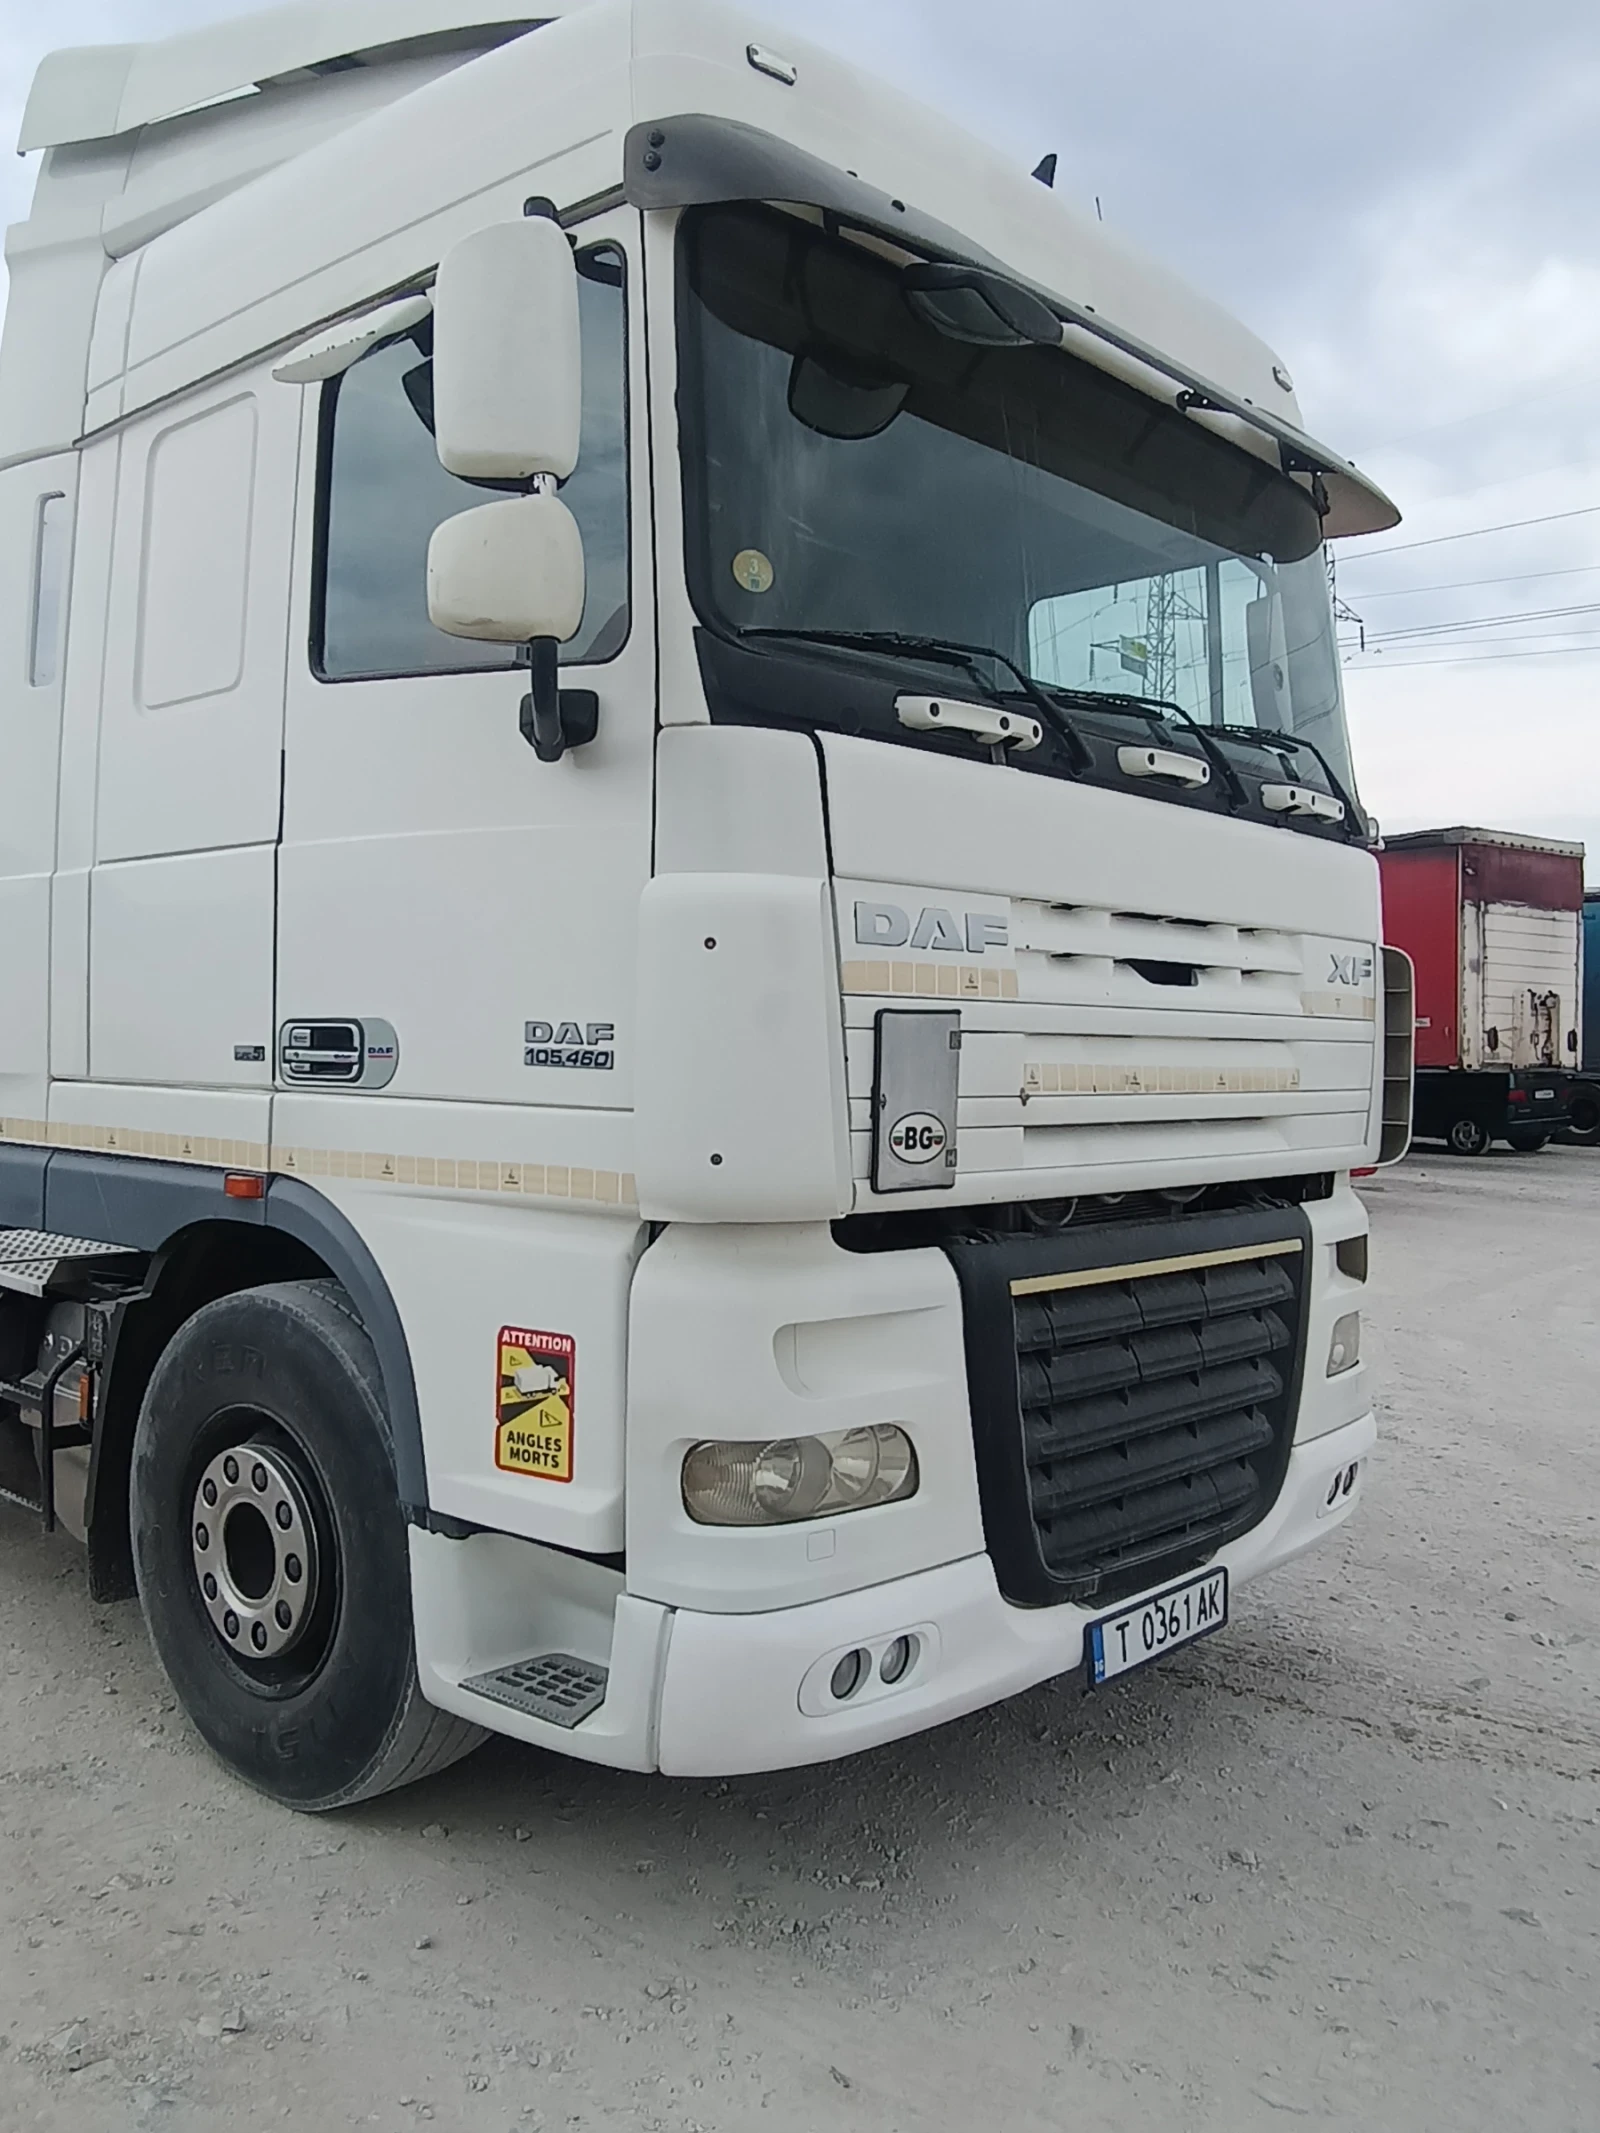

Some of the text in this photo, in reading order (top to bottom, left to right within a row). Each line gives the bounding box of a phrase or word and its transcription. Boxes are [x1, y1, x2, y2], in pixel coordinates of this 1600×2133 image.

[853, 901, 1009, 954] DAF
[1327, 953, 1372, 986] XF
[525, 1021, 615, 1046] DAF
[367, 1046, 394, 1055] DAF
[525, 1047, 611, 1068] 105.460
[904, 1126, 934, 1150] BG
[502, 1329, 571, 1353] ATTENTION
[506, 1430, 562, 1452] ANGLES
[509, 1447, 560, 1469] MORTS
[1116, 1579, 1220, 1663] T 0361 AK
